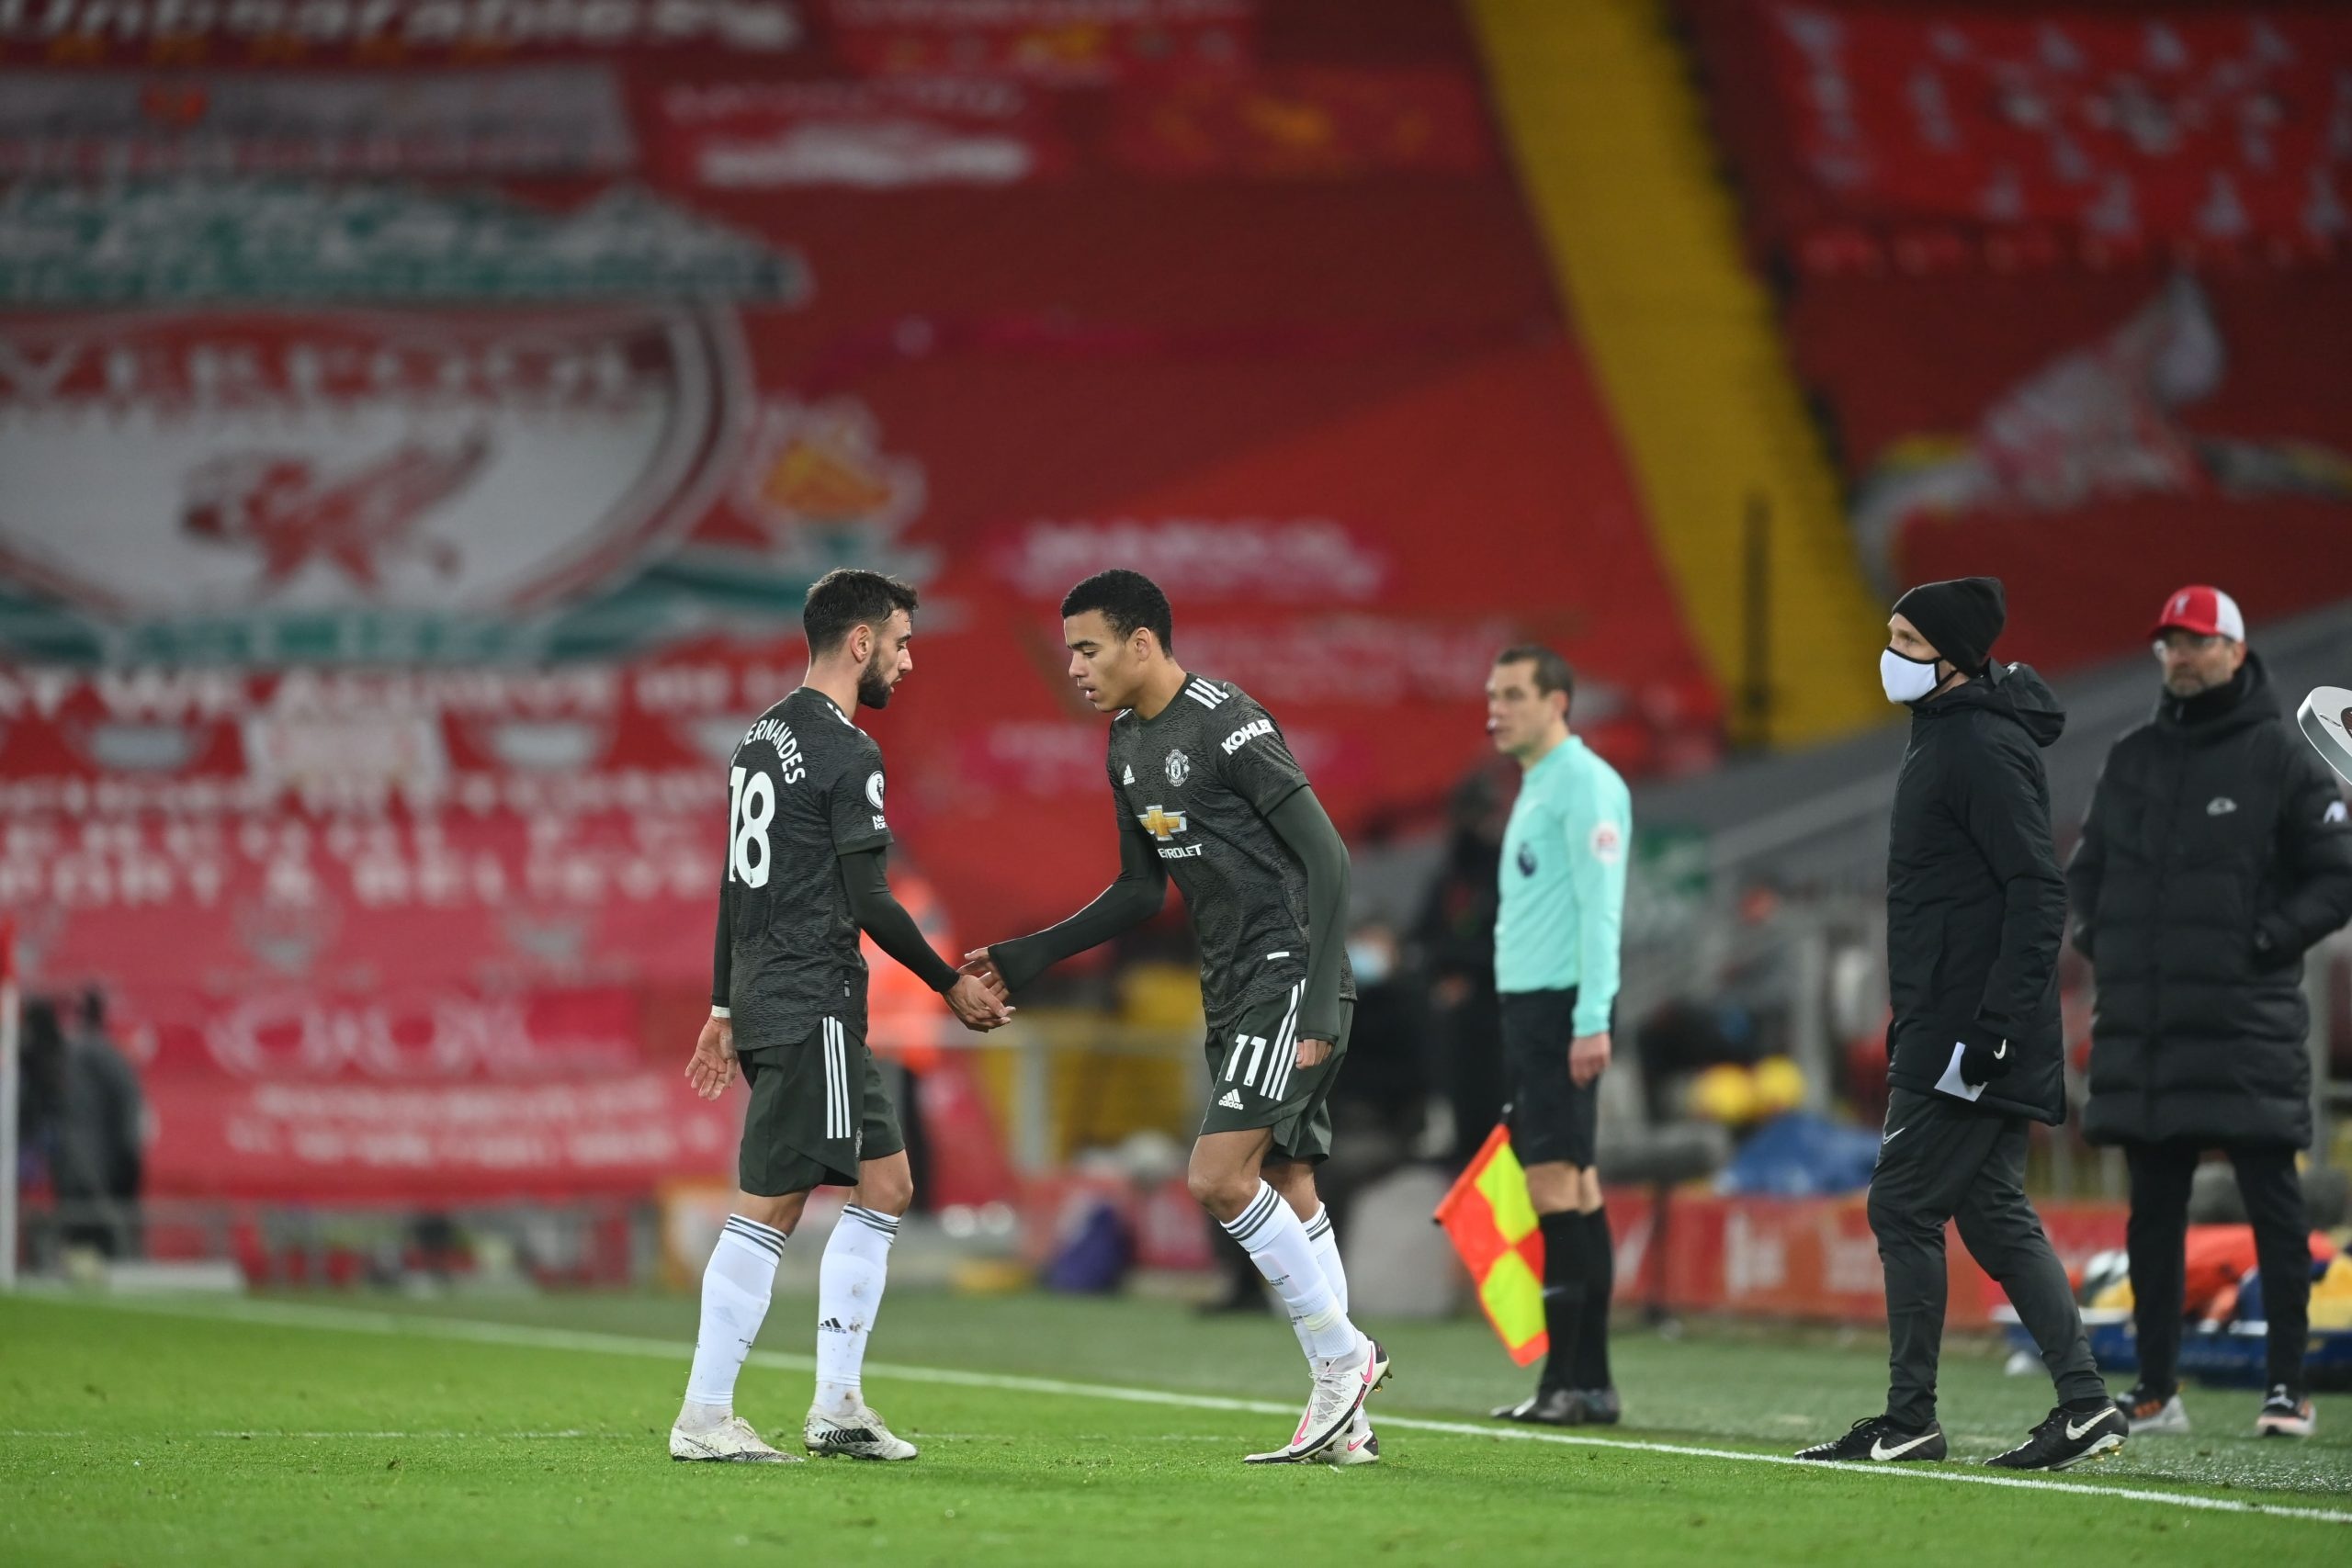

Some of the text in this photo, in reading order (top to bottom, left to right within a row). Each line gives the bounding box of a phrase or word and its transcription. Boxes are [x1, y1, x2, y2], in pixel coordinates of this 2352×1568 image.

[736, 718, 806, 784] ERNANDES
[729, 766, 775, 888] 18
[1225, 1033, 1267, 1087] 11
[1218, 1099, 1244, 1111] adidas
